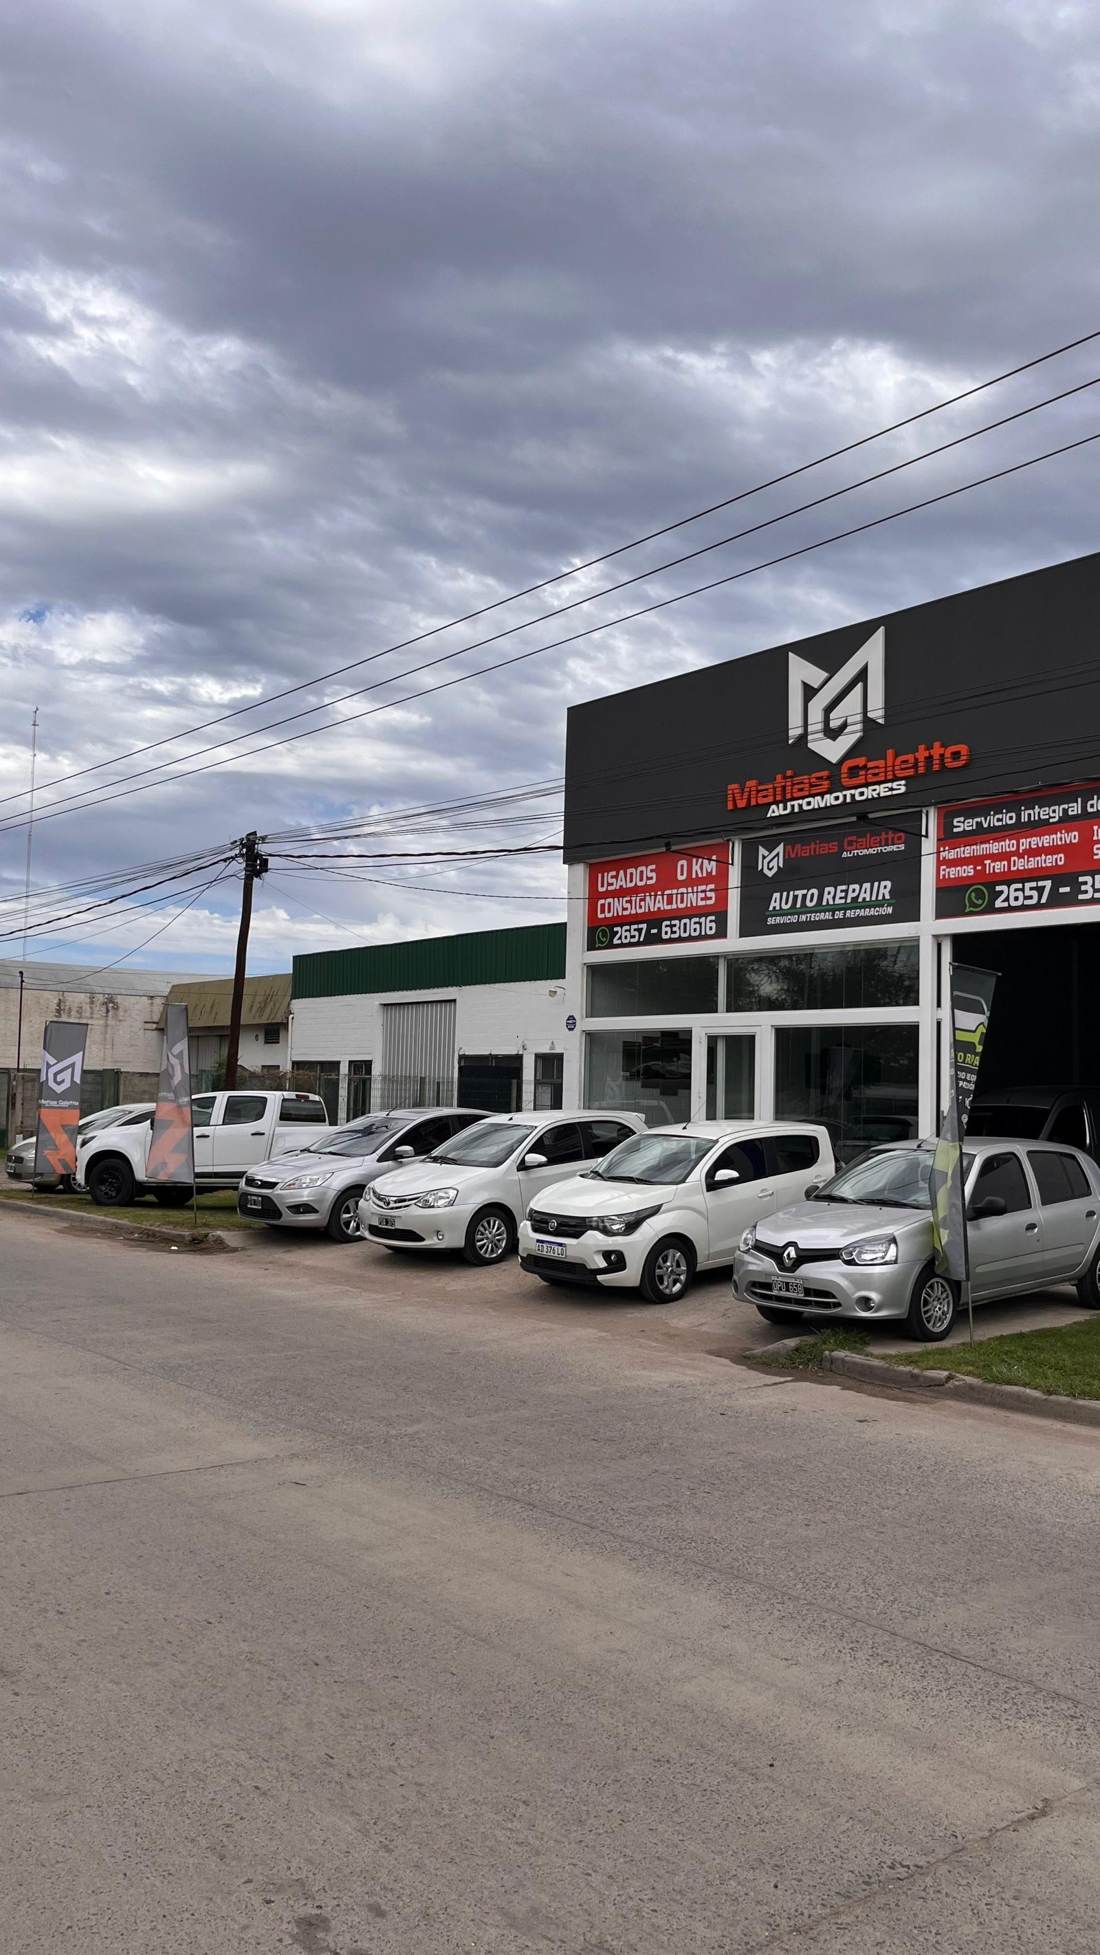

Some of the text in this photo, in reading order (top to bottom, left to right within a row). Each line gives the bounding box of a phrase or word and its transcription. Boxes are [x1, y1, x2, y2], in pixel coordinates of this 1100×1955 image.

[727, 769, 832, 811] Matias
[766, 780, 907, 818] AUTOMOTORES
[952, 809, 1016, 833] Servicio
[1021, 797, 1082, 823] integral
[785, 839, 839, 859] Matias
[841, 844, 905, 858] AUTOMOTORES
[939, 838, 1017, 860] Mantenimiento
[1019, 830, 1079, 853] preventivo
[597, 864, 657, 892] USADOS
[692, 855, 717, 879] KM
[939, 864, 974, 880] Frenos
[984, 859, 1008, 874] Tren
[1010, 853, 1065, 871] Delantero
[597, 883, 716, 919] CONSIGNACIONES
[769, 880, 892, 911] AUTO REPAIR
[994, 879, 1052, 908] 2657
[767, 904, 893, 925] SERVICIO INTEGRAL DE REPARACIÓN
[612, 922, 647, 945] 2657
[661, 915, 717, 940] 630616
